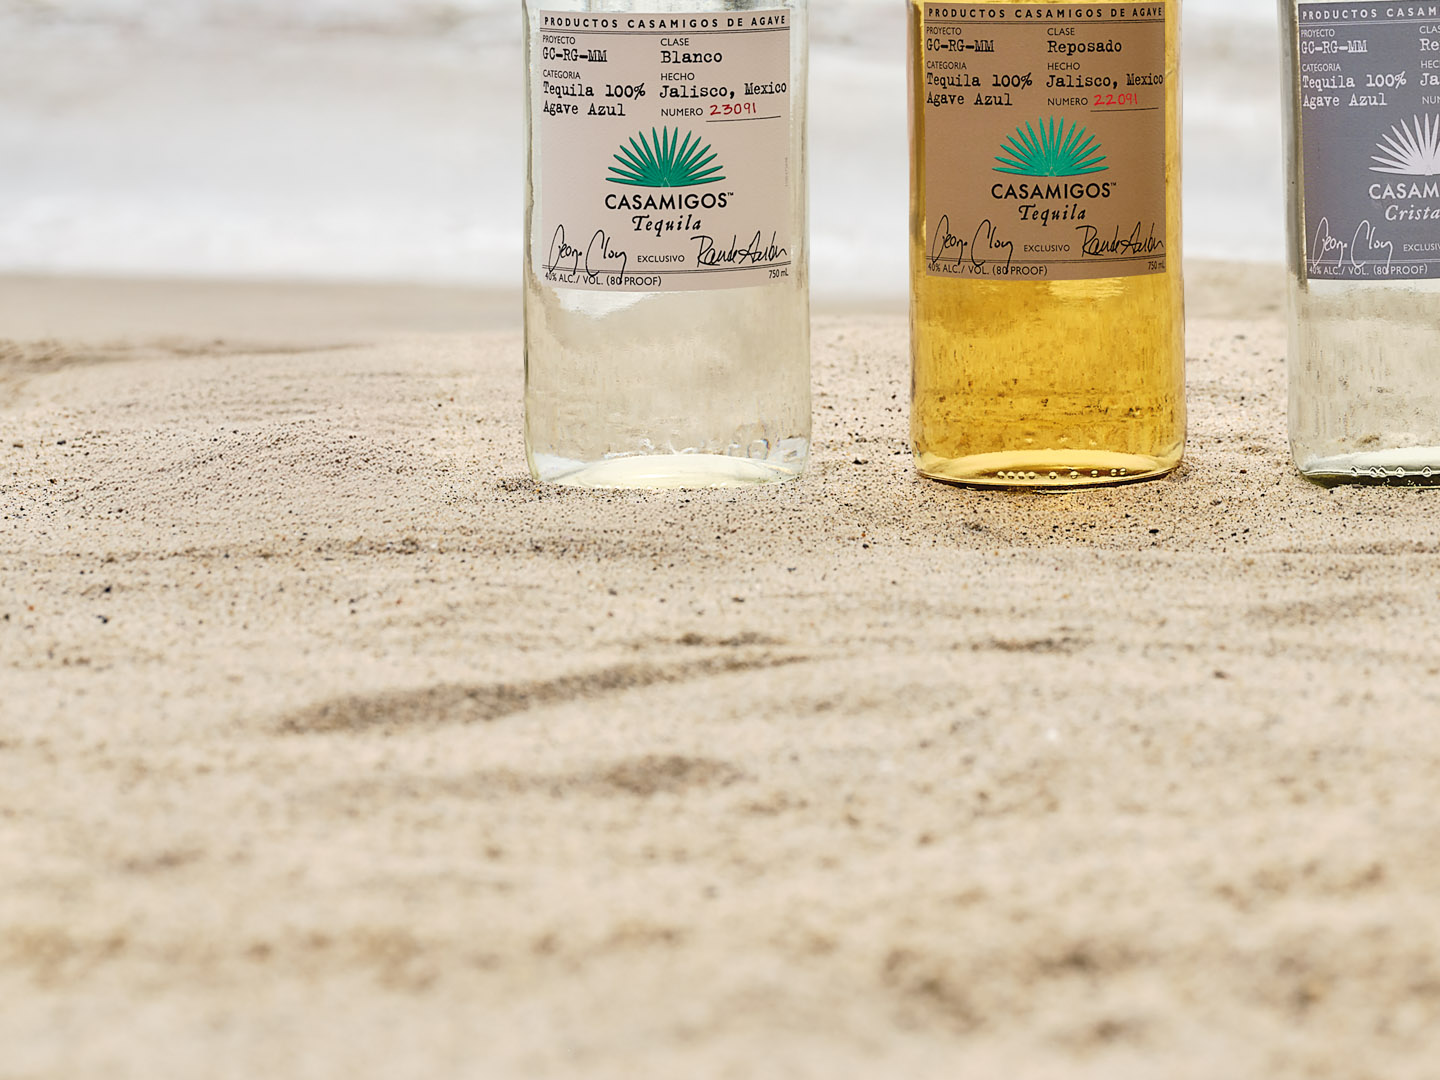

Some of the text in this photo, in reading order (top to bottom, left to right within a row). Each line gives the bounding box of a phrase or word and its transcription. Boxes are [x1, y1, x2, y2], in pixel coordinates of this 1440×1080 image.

[928, 7, 1163, 18] PRODUCTOS CASAMIGOS DE AGAVE
[1302, 8, 1378, 20] PRODUCTOS
[544, 15, 786, 29] PRODUCTOS CASAMIGOS DE AGAVE
[926, 26, 962, 36] PROYECTO
[1047, 28, 1075, 36] CLASE
[1300, 28, 1335, 38] PROYECTO
[542, 35, 576, 45] PROYECTO
[660, 37, 690, 47] CLASE
[926, 38, 995, 53] GC-RG-MM
[1300, 39, 1368, 54] GC-RG-MM
[1047, 40, 1122, 56] Reposado
[542, 48, 608, 63] GC-RG-MM
[660, 50, 723, 64] Blanco
[926, 61, 967, 70] CATEGORIA
[1047, 62, 1081, 71] HECHO
[1301, 62, 1341, 72] CATEGORIA
[542, 70, 581, 80] CATEGORIA
[660, 72, 695, 82] HECHO
[926, 72, 1033, 89] Tequila 100%
[1046, 72, 1164, 89] Jalisco, Mexico
[1302, 71, 1407, 90] Tequila 100%
[542, 81, 646, 99] Tequila 100%
[659, 82, 787, 99] Jalisco, Mexico
[926, 91, 1013, 107] Agave Azul
[1047, 93, 1138, 106] NUMERO 22091
[1302, 93, 1388, 109] Agave Azul
[542, 101, 626, 117] Agave Azul
[661, 102, 757, 117] NUMERO 23091
[1018, 204, 1086, 226] Tequila
[631, 214, 702, 238] Tequila
[1023, 244, 1071, 253] EXCLUSIVO
[637, 254, 685, 263] EXCLUSIVO
[927, 263, 941, 273] 40%
[968, 265, 990, 275] VOL.
[1009, 265, 1048, 276] PROOF)
[1147, 261, 1158, 270] 750
[1348, 265, 1370, 276] VOL.
[1390, 264, 1428, 275] PROOF)
[582, 275, 604, 285] VOL.
[624, 276, 662, 286] PROOF)
[768, 269, 779, 279] 750
